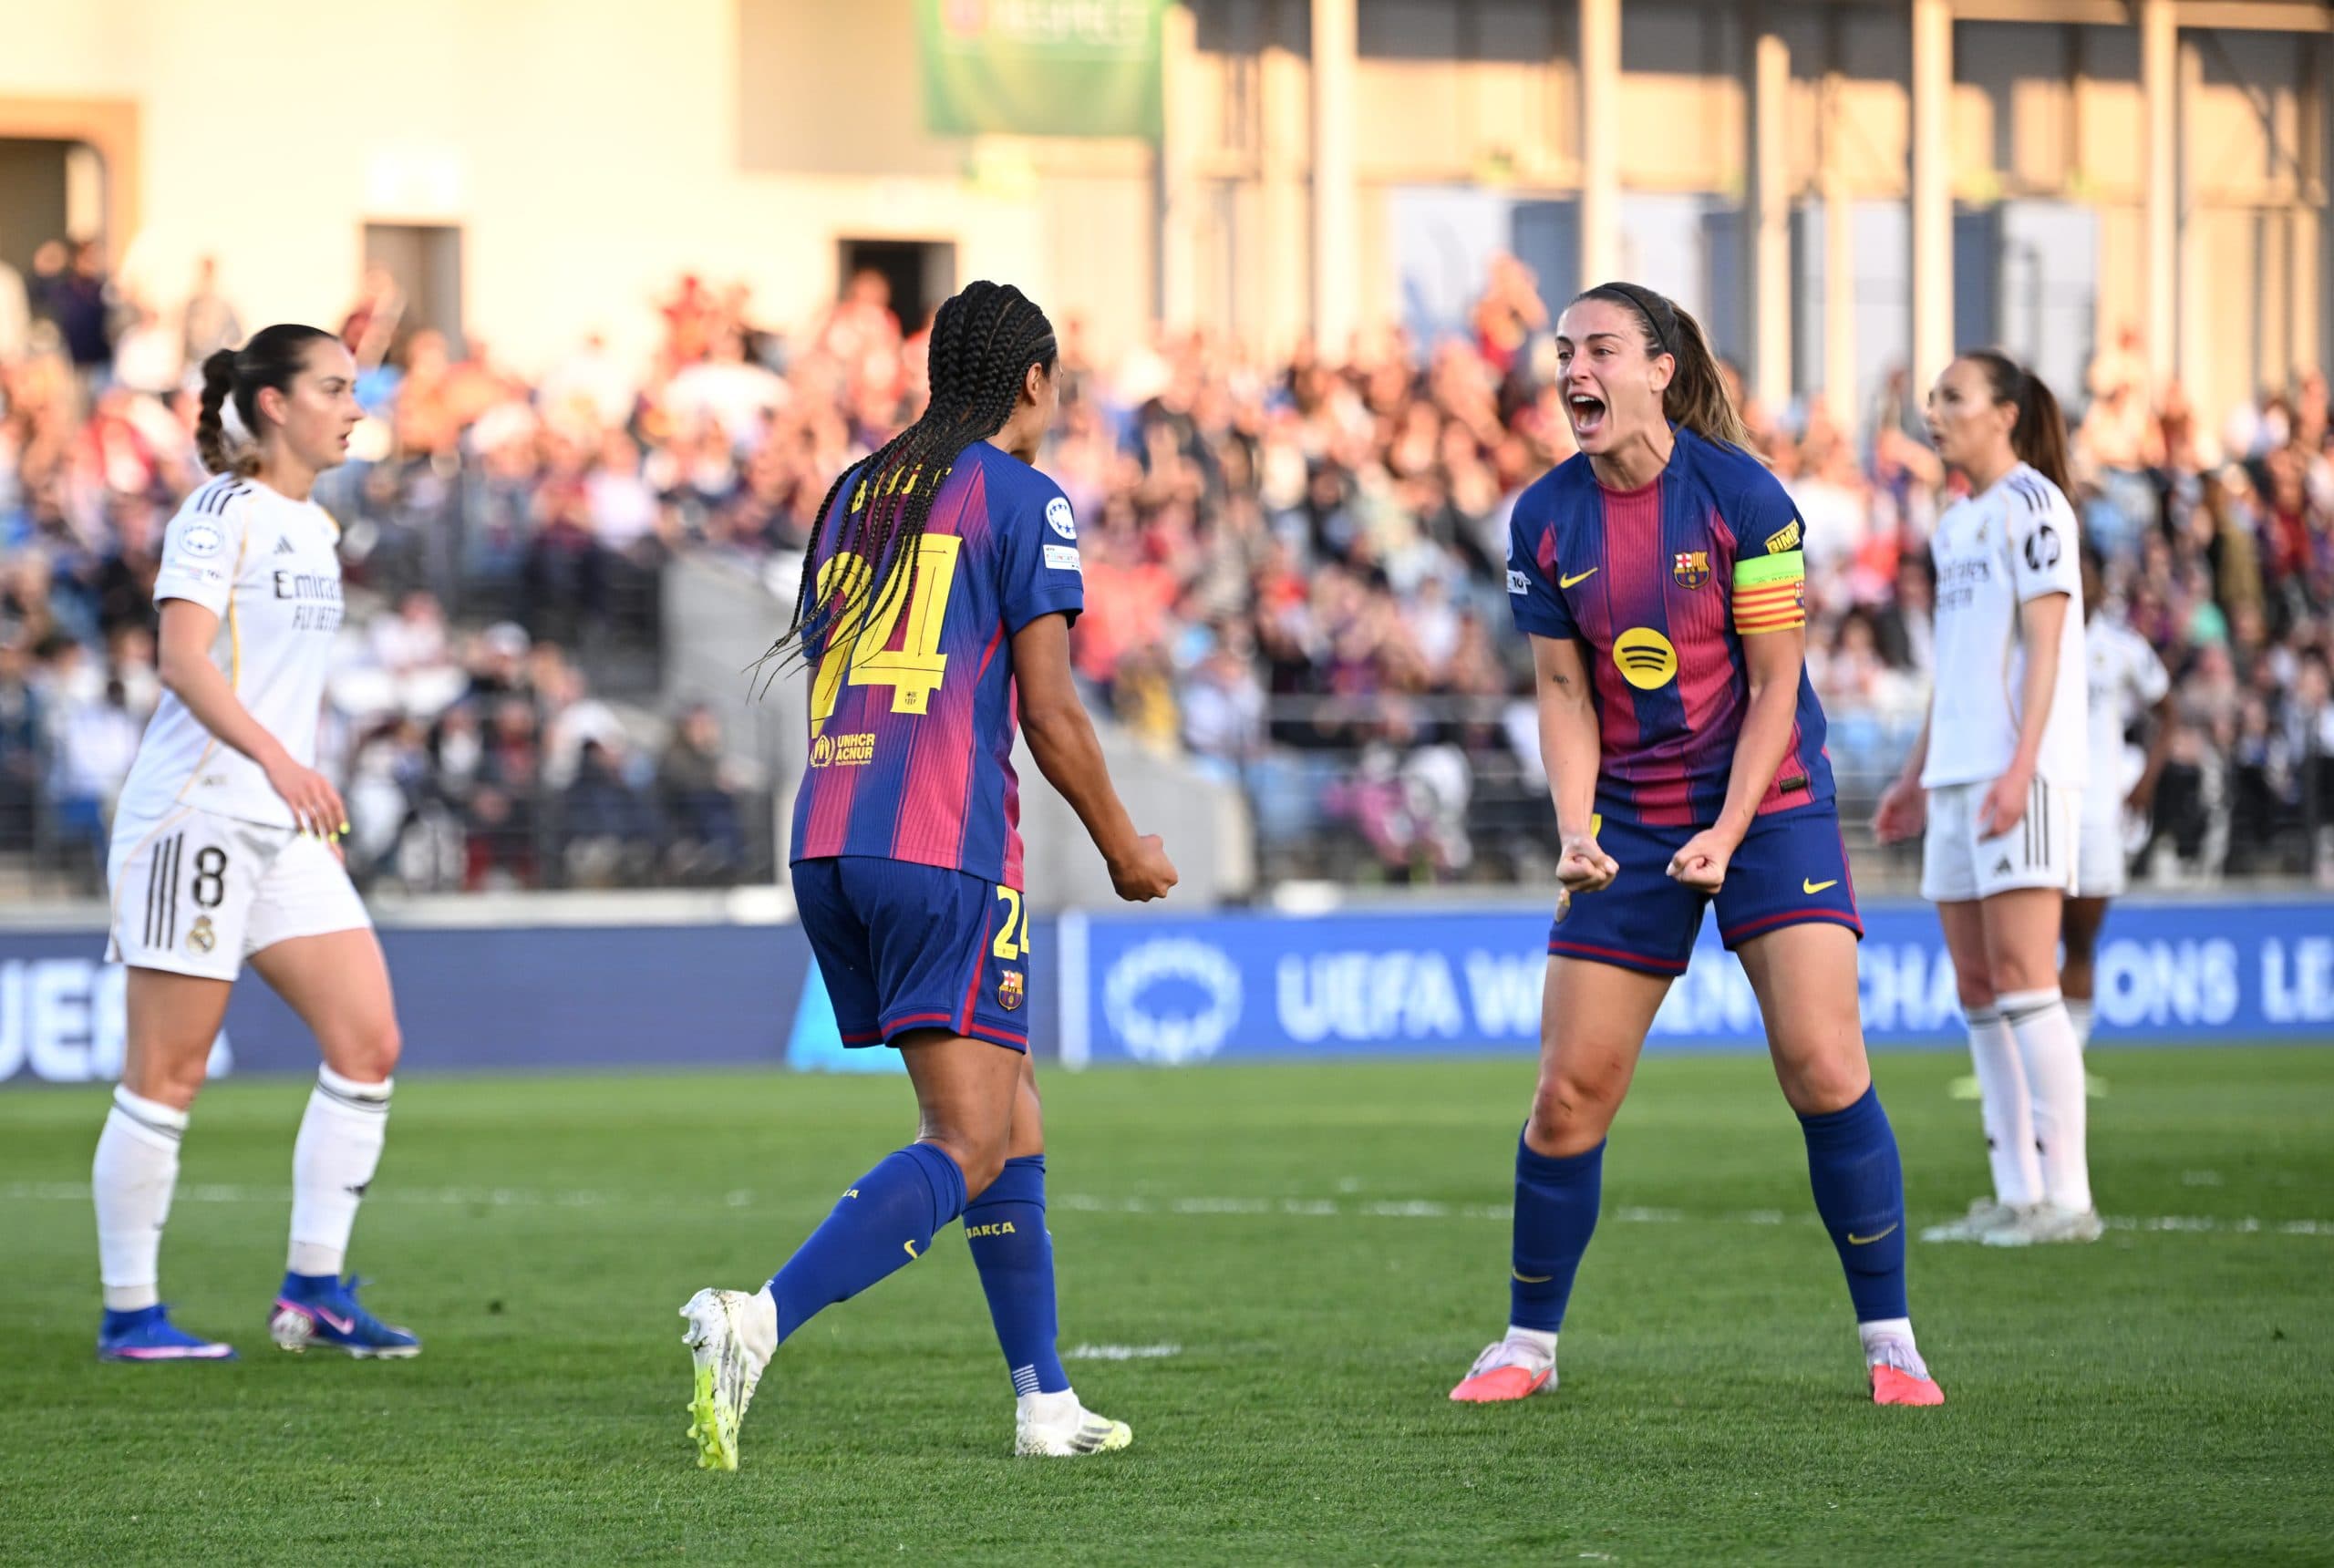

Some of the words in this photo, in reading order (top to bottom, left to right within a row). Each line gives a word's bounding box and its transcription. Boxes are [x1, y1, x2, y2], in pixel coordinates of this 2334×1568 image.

[810, 532, 964, 739] 24
[835, 747, 873, 761] ACNUR
[837, 733, 875, 748] UNHCR
[192, 847, 226, 908] 8
[1276, 948, 1464, 1041] UEFA
